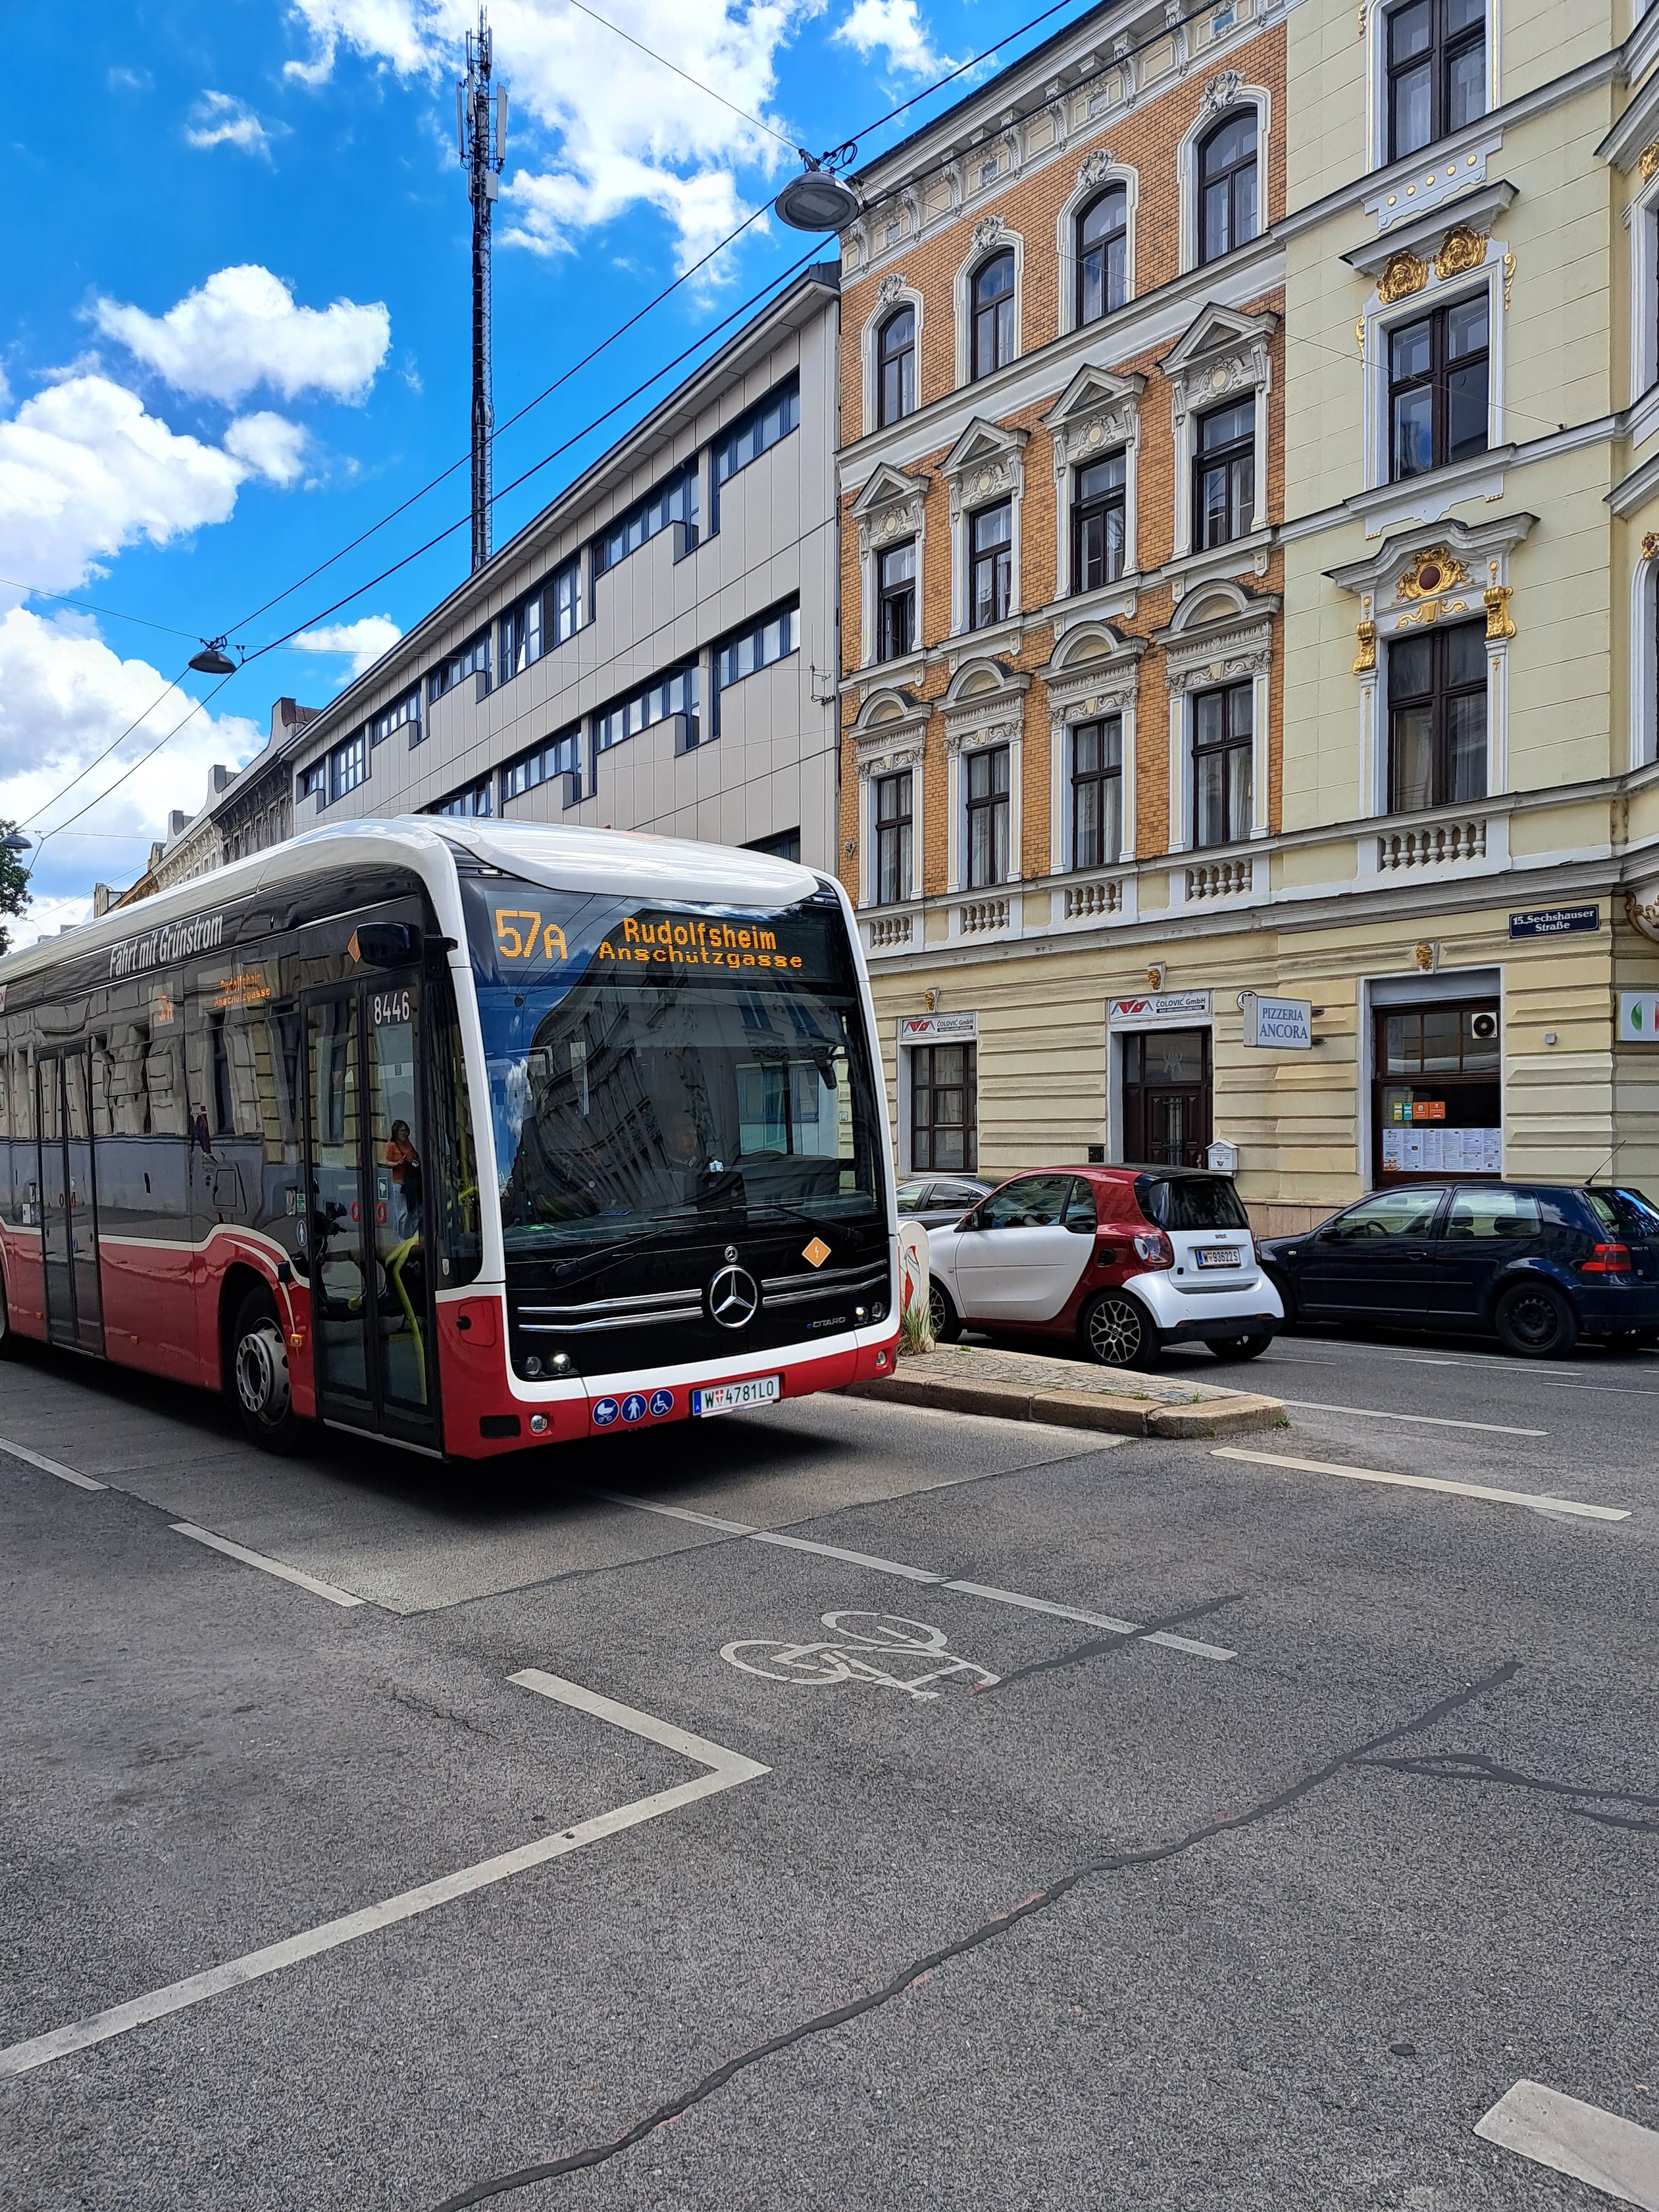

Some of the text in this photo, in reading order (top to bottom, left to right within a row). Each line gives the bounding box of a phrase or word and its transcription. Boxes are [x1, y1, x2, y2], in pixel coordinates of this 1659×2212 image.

[1527, 910, 1594, 923] Sechshauser
[495, 909, 777, 960] 57A Rudolfsheim
[1535, 921, 1571, 932] Straße
[109, 914, 224, 979] Fährt mit Grünstrom
[598, 941, 804, 969] Anschützgasse
[374, 991, 410, 1025] 8446
[1185, 997, 1206, 1005] GmbH
[1262, 1007, 1304, 1021] PIZZERIA
[1259, 1023, 1308, 1039] ANCORA
